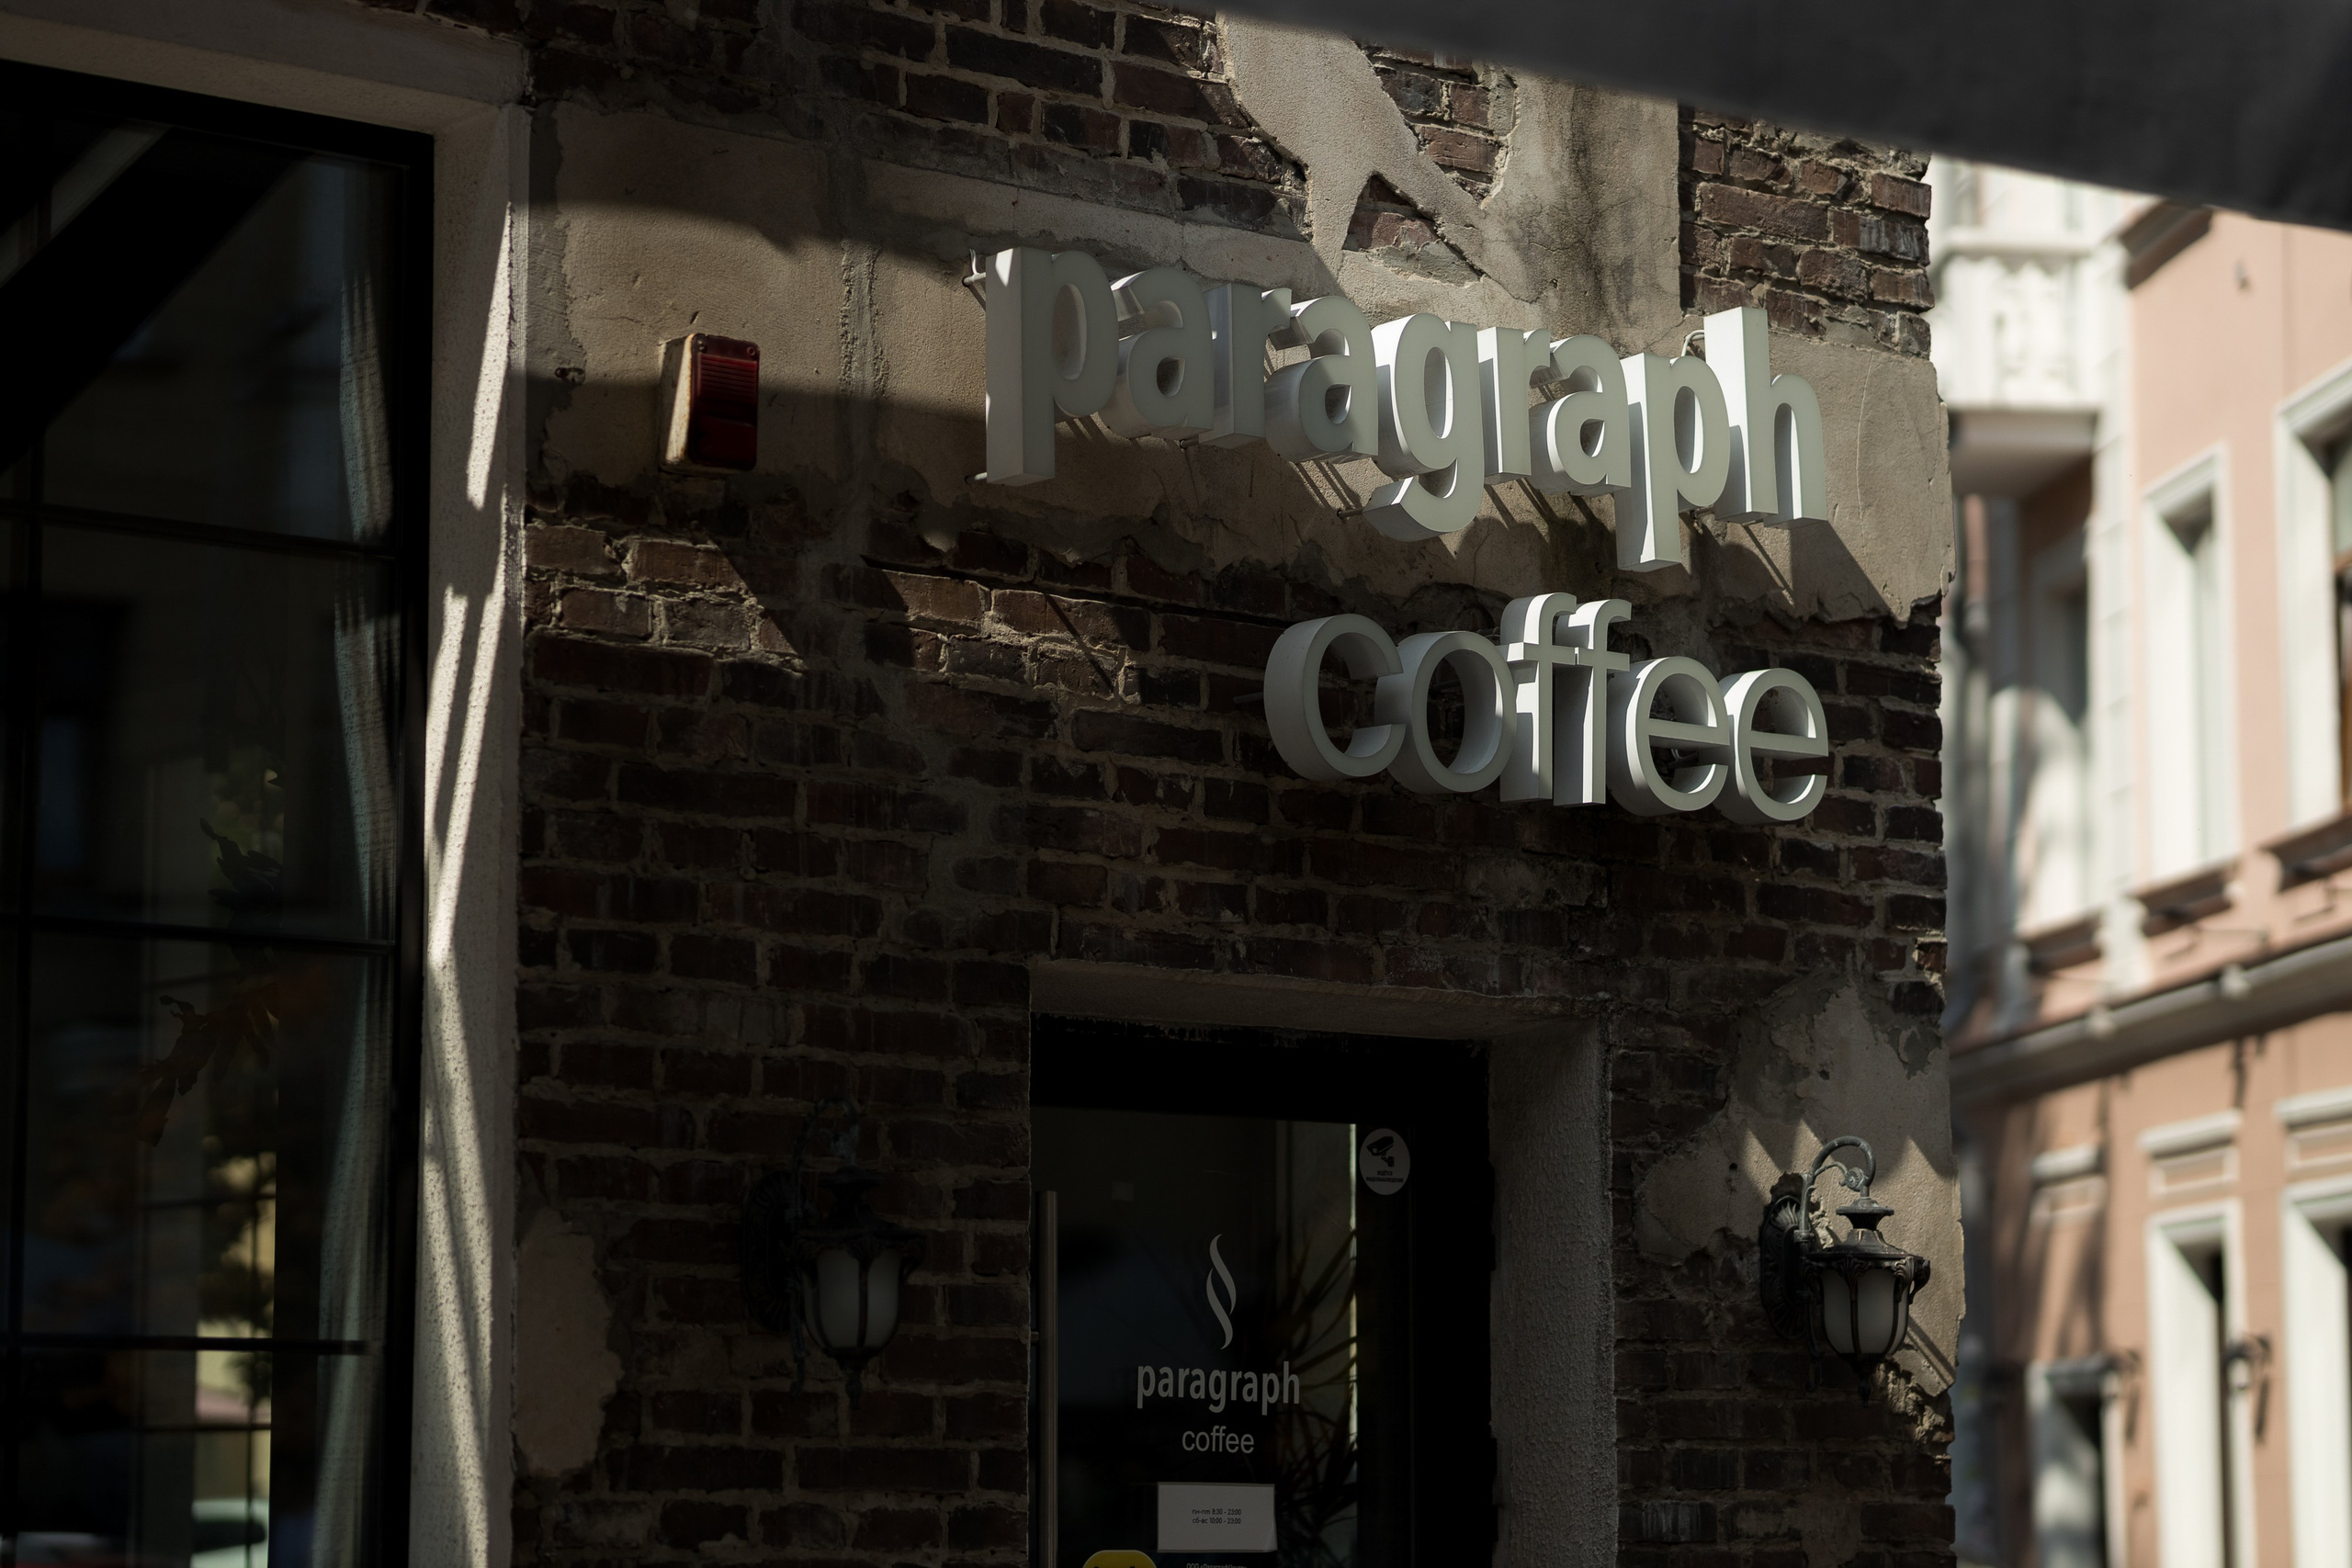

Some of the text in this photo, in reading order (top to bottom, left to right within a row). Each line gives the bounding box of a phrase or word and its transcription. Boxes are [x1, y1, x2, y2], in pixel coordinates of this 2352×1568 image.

[985, 246, 1827, 570] paragraph
[1264, 592, 1829, 824] coffee
[1136, 1360, 1300, 1416] paragraph
[1182, 1425, 1254, 1453] coffee
